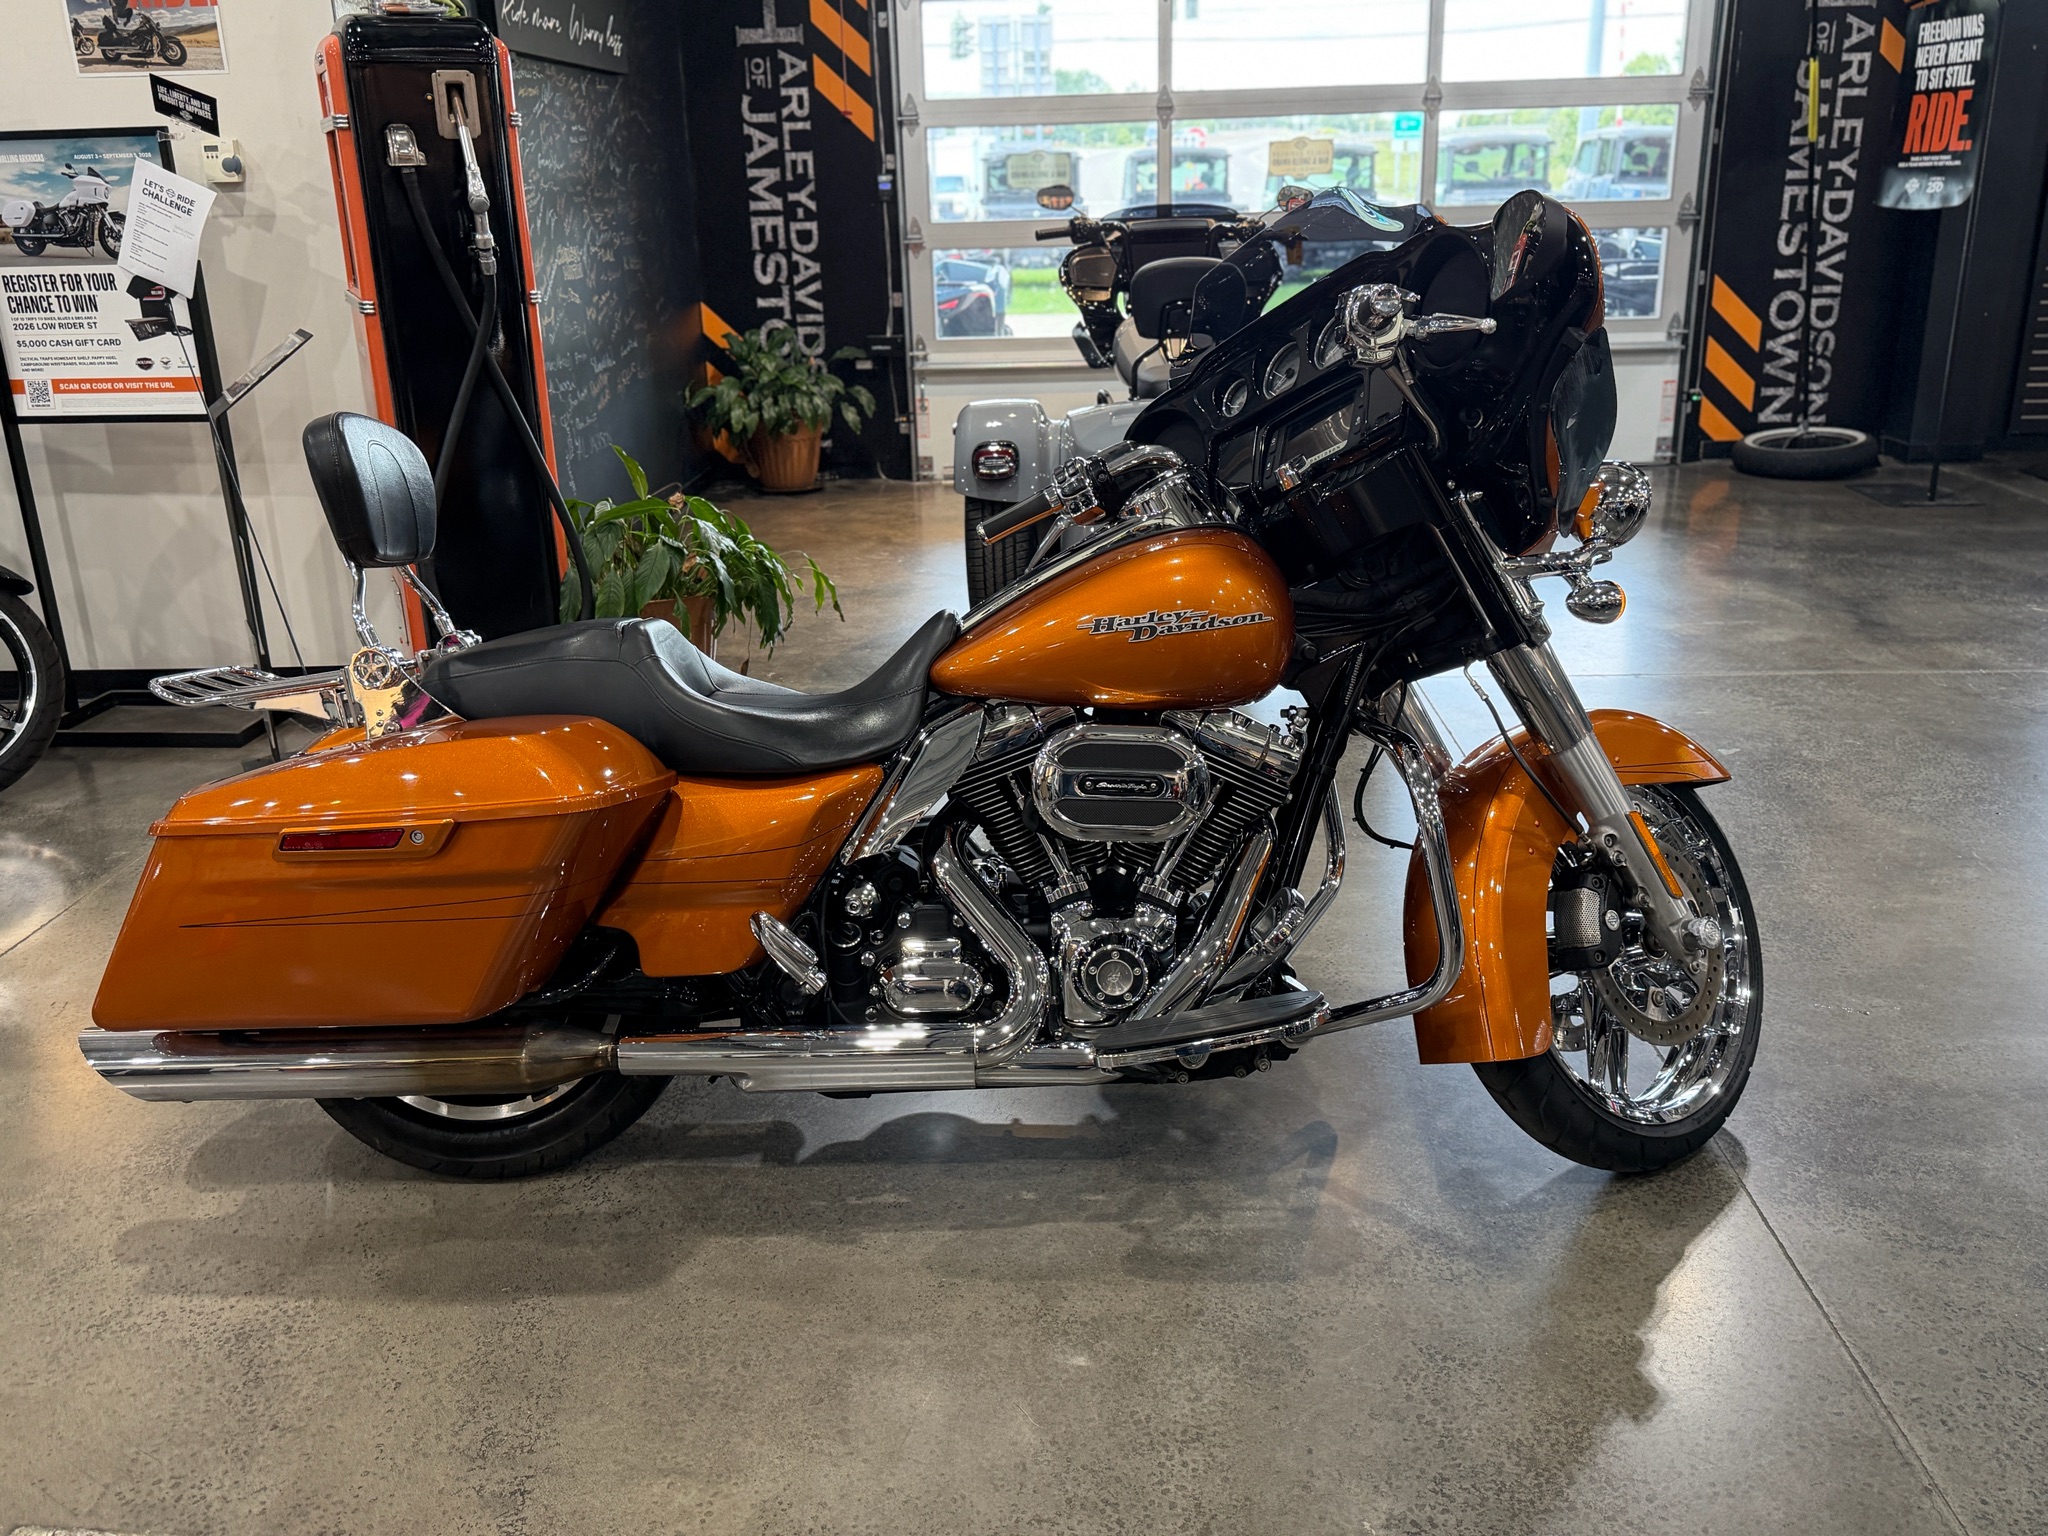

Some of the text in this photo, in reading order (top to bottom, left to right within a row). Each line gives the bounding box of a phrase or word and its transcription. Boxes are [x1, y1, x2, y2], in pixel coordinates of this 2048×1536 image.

[569, 3, 604, 53] Worry
[1918, 13, 1984, 44] FREEDOM WAS
[1914, 38, 1984, 68] NEVER MEANT
[750, 57, 766, 88] OF
[1915, 63, 1975, 91] TO SIT STILL.
[1902, 89, 1974, 154] RIDE.
[142, 187, 194, 217] CHALLENGE
[144, 178, 196, 207] LET'S RIDE
[1, 273, 118, 293] REGISTER FOR YOUR
[6, 295, 55, 314] CHANCE
[55, 294, 71, 313] TO
[12, 321, 98, 331] 2026 LOW RIDER ST
[16, 338, 121, 348] $5,000 CASH GIFT CARD
[1077, 608, 1209, 635] Harley
[1118, 611, 1273, 643] Davidson
